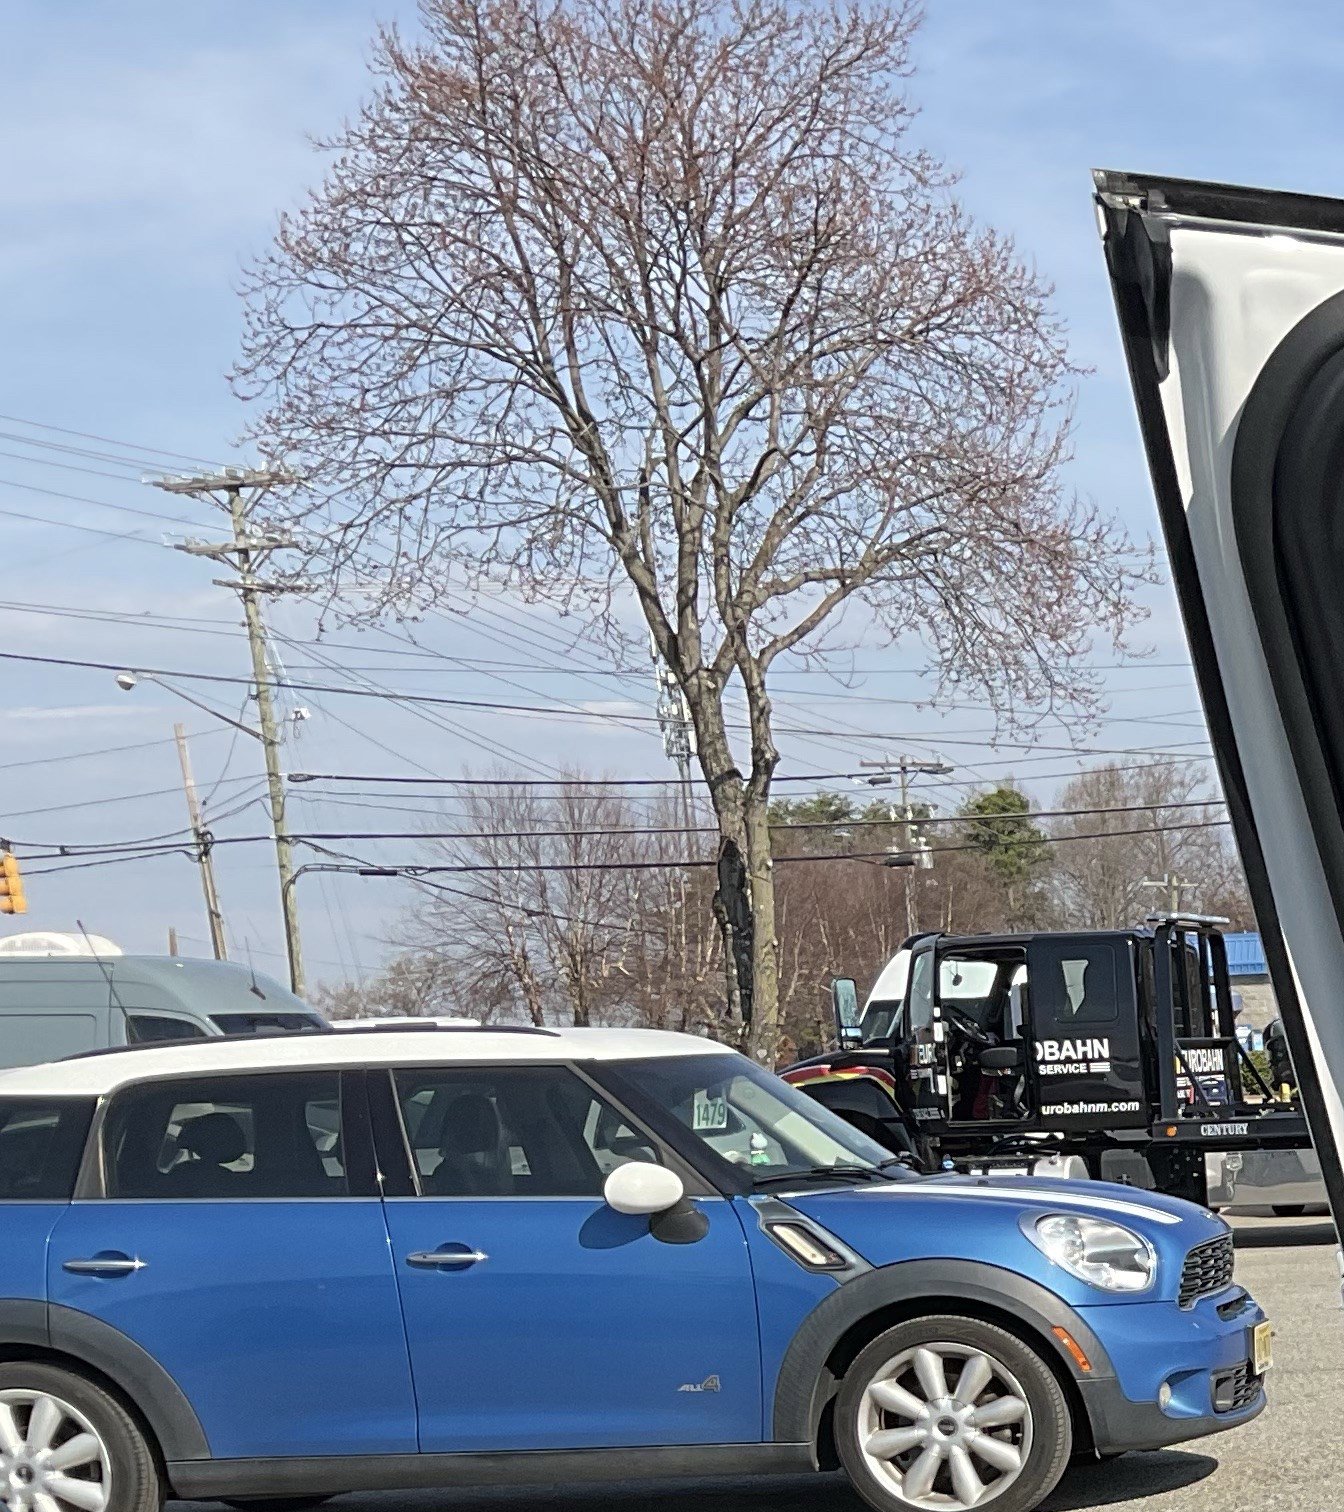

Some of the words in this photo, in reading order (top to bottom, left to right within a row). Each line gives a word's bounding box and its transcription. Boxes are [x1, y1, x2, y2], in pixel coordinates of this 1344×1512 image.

[1039, 1062, 1088, 1075] SERVICE
[697, 1102, 726, 1127] 1479
[1041, 1100, 1140, 1115] urobahnm.com
[1200, 1122, 1249, 1136] CENTURY
